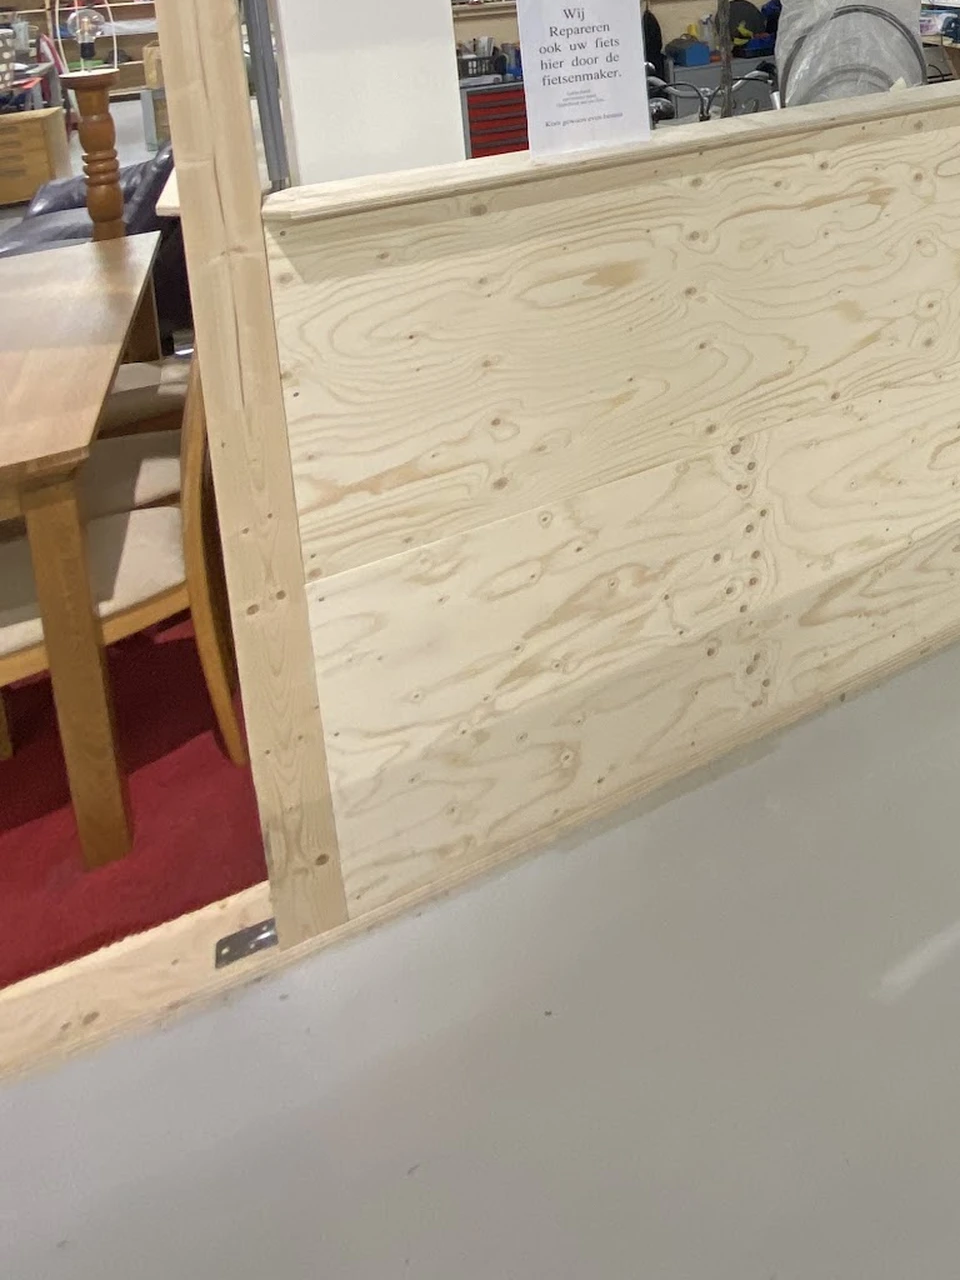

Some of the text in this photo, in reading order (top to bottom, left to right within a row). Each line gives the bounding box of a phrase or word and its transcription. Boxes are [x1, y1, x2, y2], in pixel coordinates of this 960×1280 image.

[562, 7, 586, 22] Wij
[549, 24, 610, 39] Repareren
[539, 36, 620, 54] ook uw fiets
[540, 52, 620, 71] hier door de
[542, 69, 622, 87] fietsenmaker.
